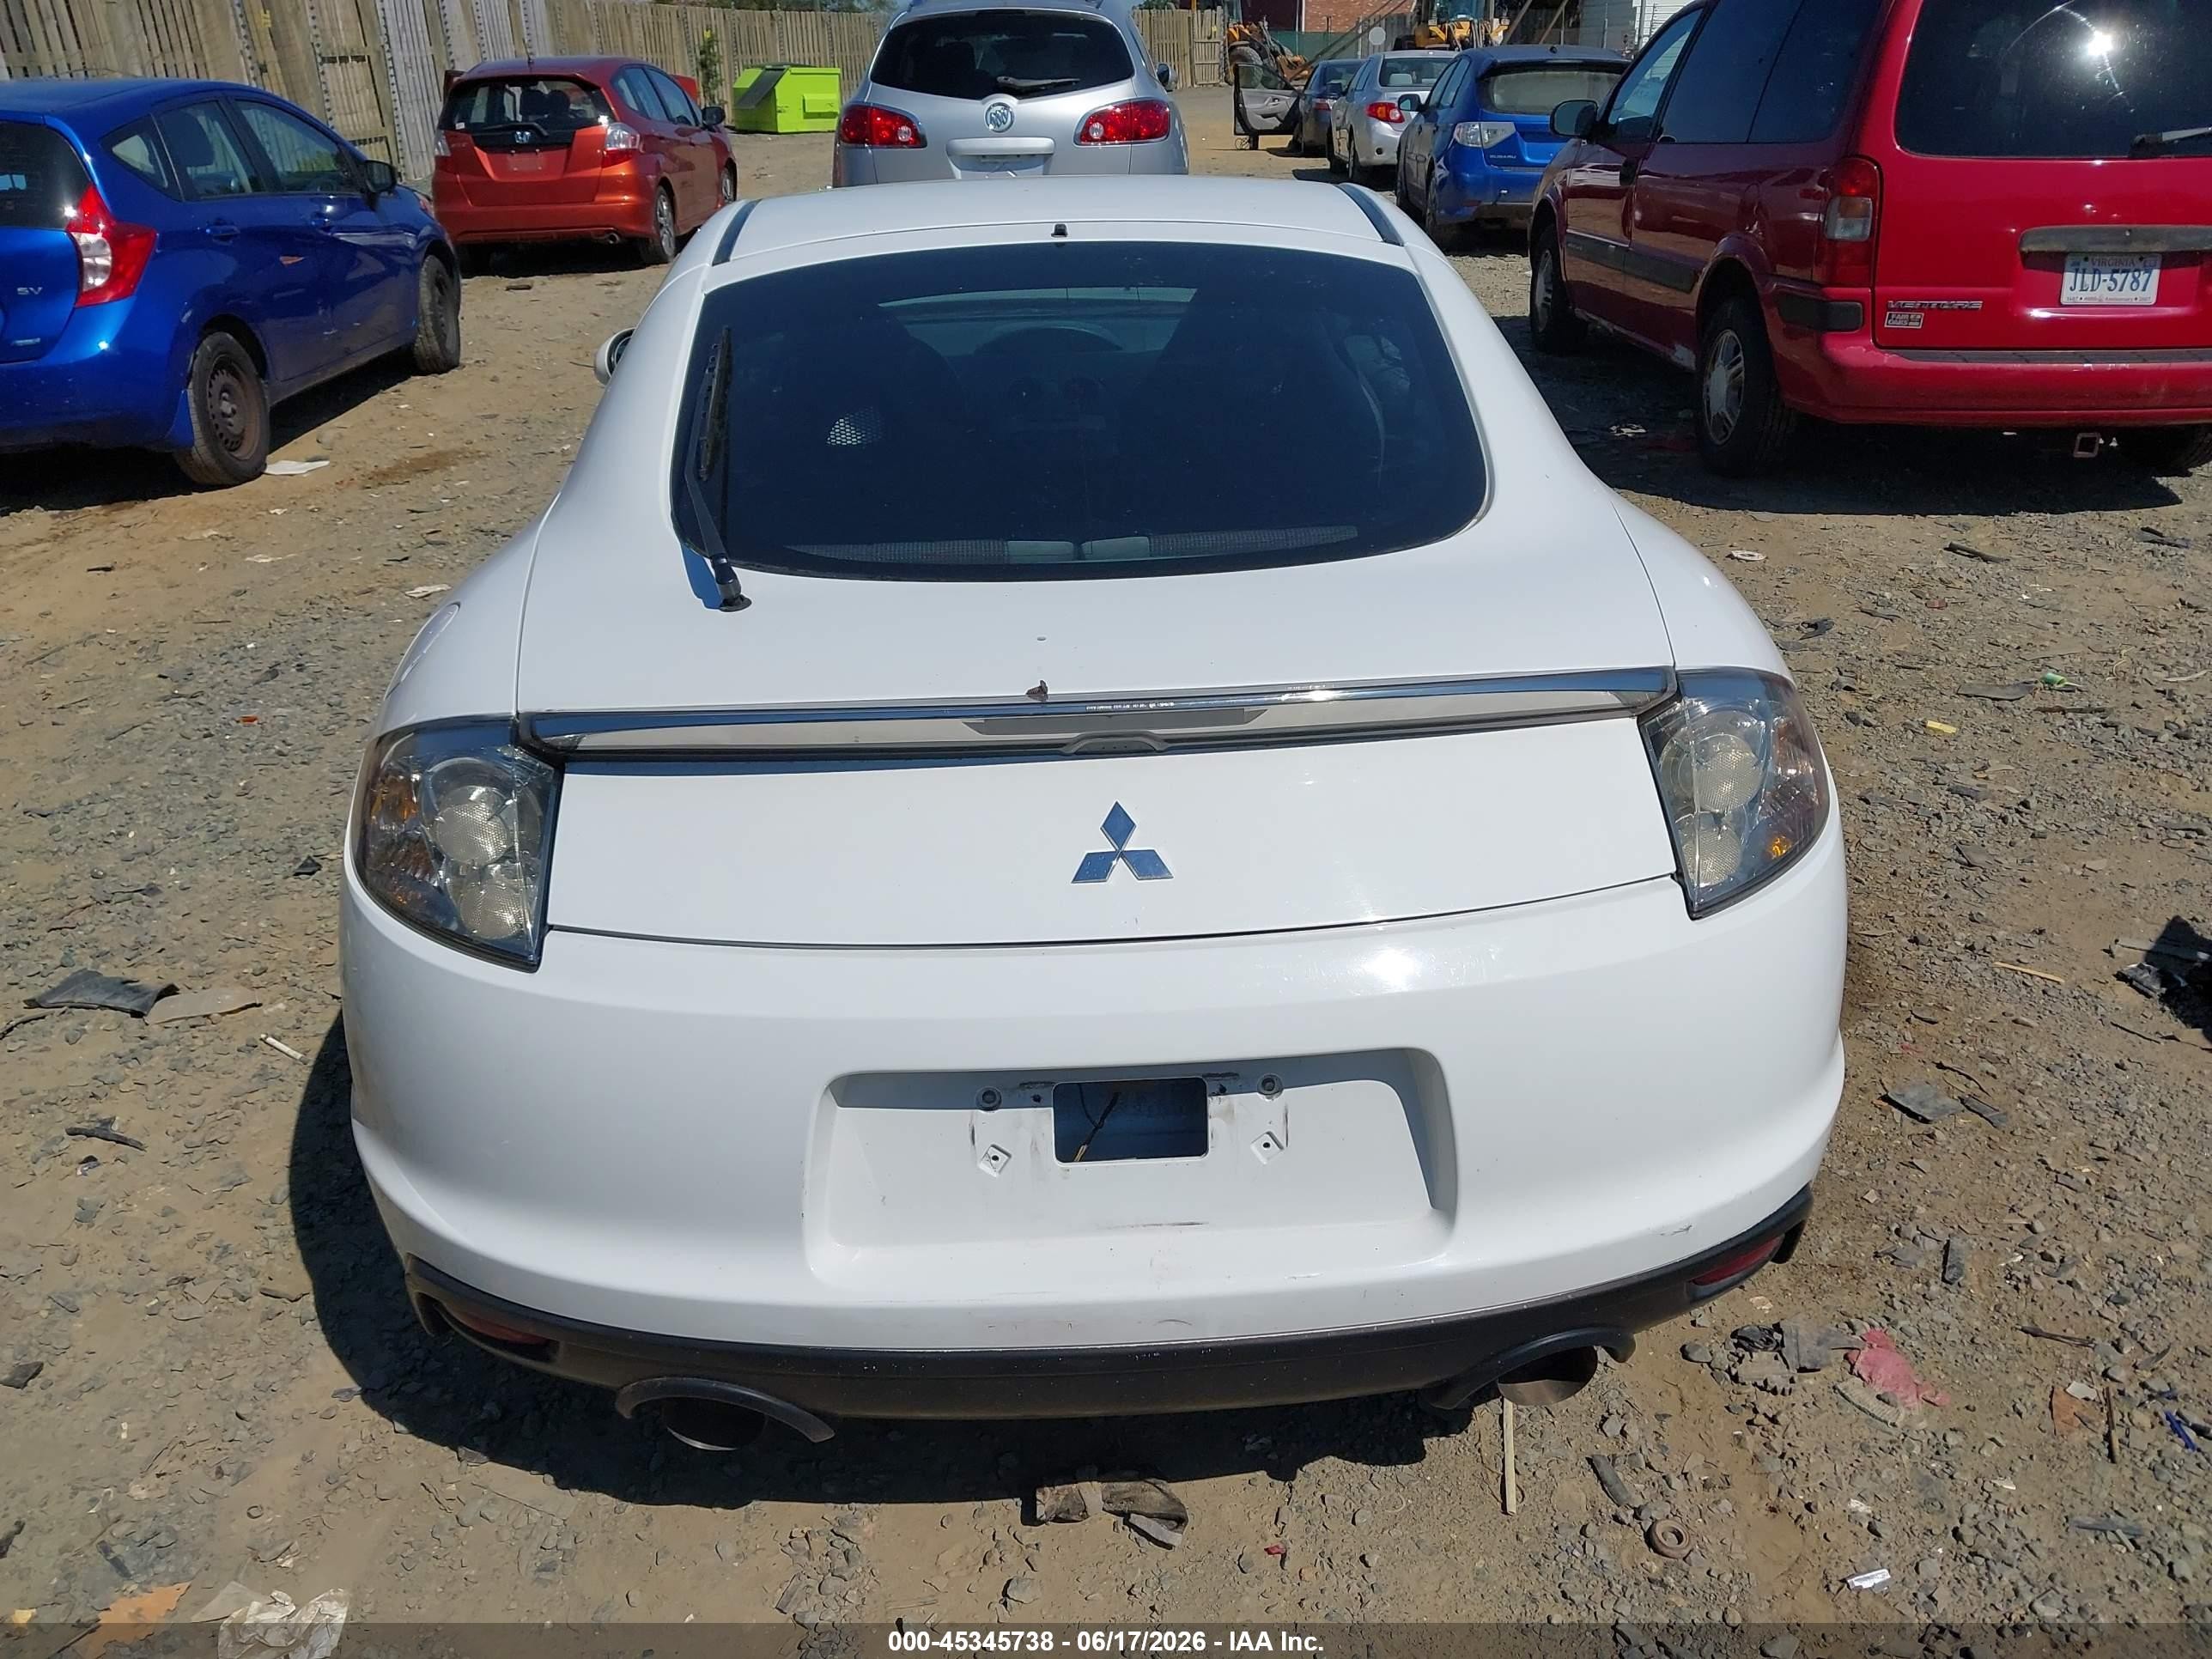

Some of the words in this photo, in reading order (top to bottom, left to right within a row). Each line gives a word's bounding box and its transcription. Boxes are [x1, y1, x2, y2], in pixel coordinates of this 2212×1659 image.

[2091, 257, 2135, 267] VIRGINIA
[2069, 267, 2154, 292] JLD-5787
[1887, 300, 1984, 310] VENTURE
